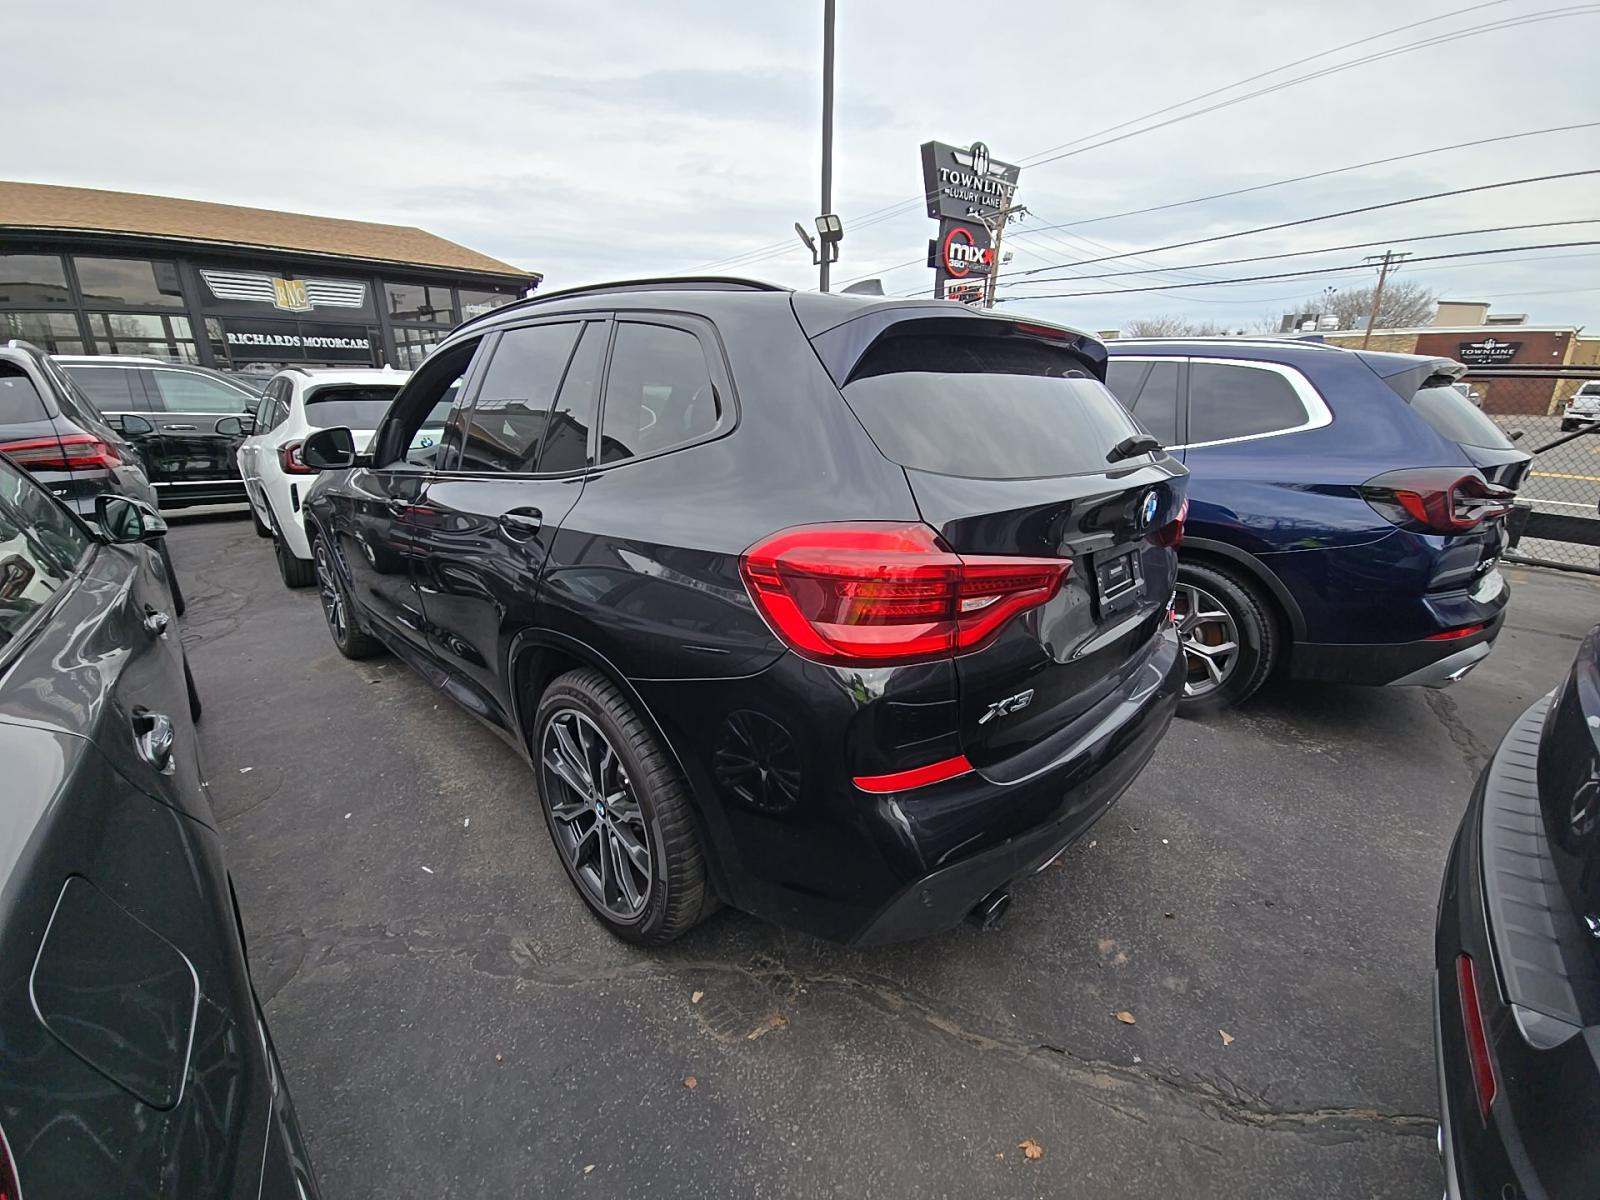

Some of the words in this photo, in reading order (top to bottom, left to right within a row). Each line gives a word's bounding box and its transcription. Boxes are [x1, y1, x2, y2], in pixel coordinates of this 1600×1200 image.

[949, 187, 979, 202] LUXURY
[981, 196, 1002, 209] LANE
[226, 332, 301, 347] RICHARDS
[301, 336, 370, 349] MOTORCARS
[978, 688, 1035, 725] X3
